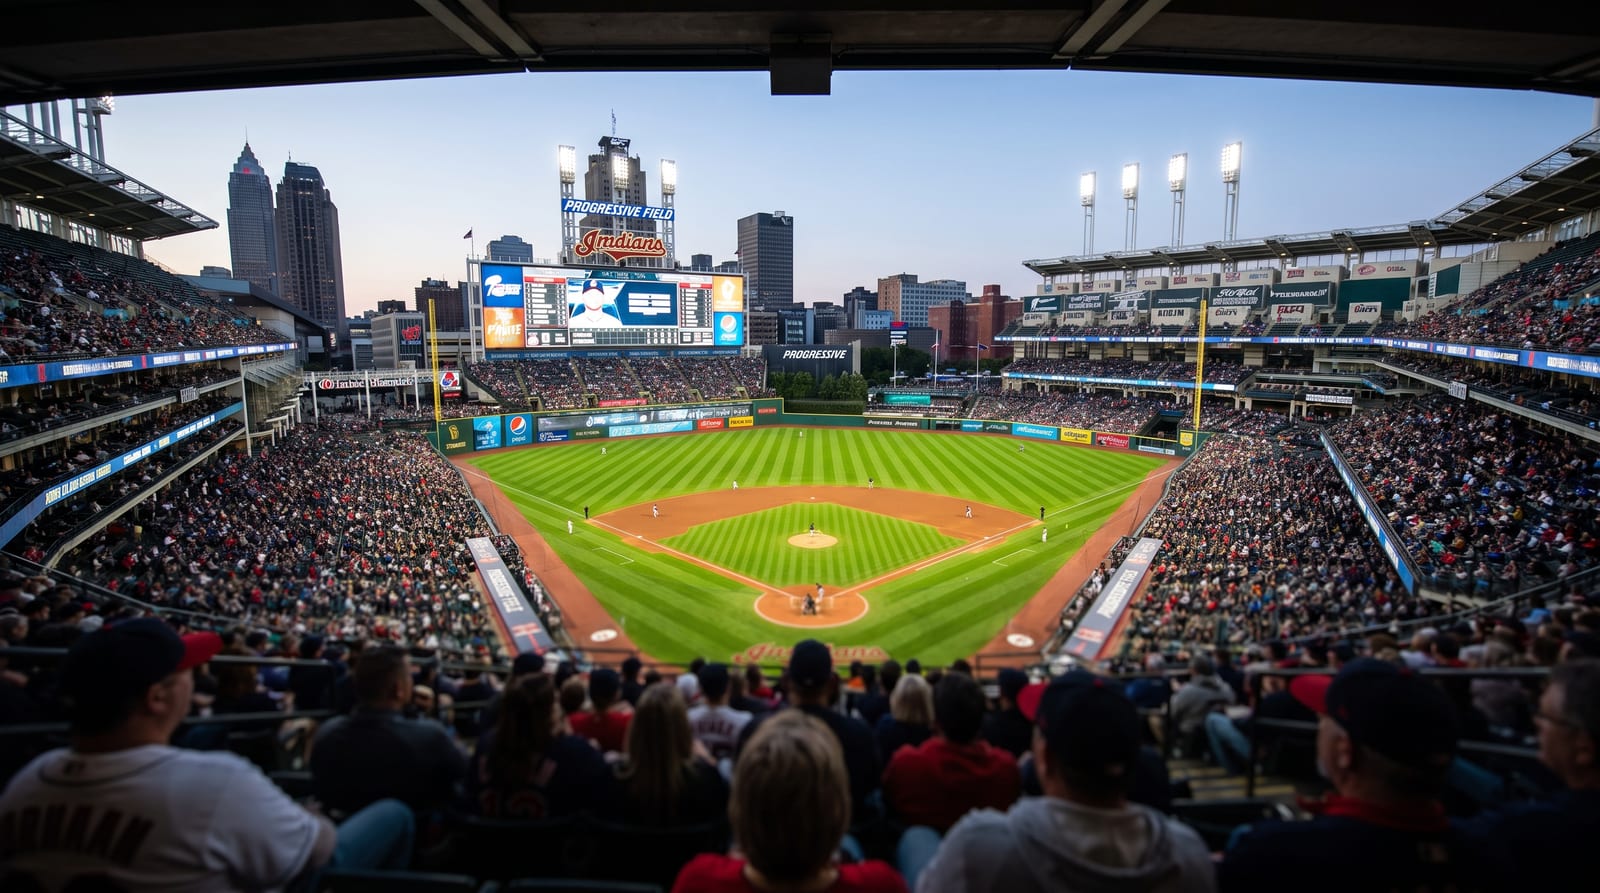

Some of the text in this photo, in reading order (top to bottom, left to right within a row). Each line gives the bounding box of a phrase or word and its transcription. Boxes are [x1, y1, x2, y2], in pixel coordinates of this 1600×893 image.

[564, 200, 673, 220] PROGRESSIVE FIELD
[782, 350, 847, 360] PROGRESSIVE
